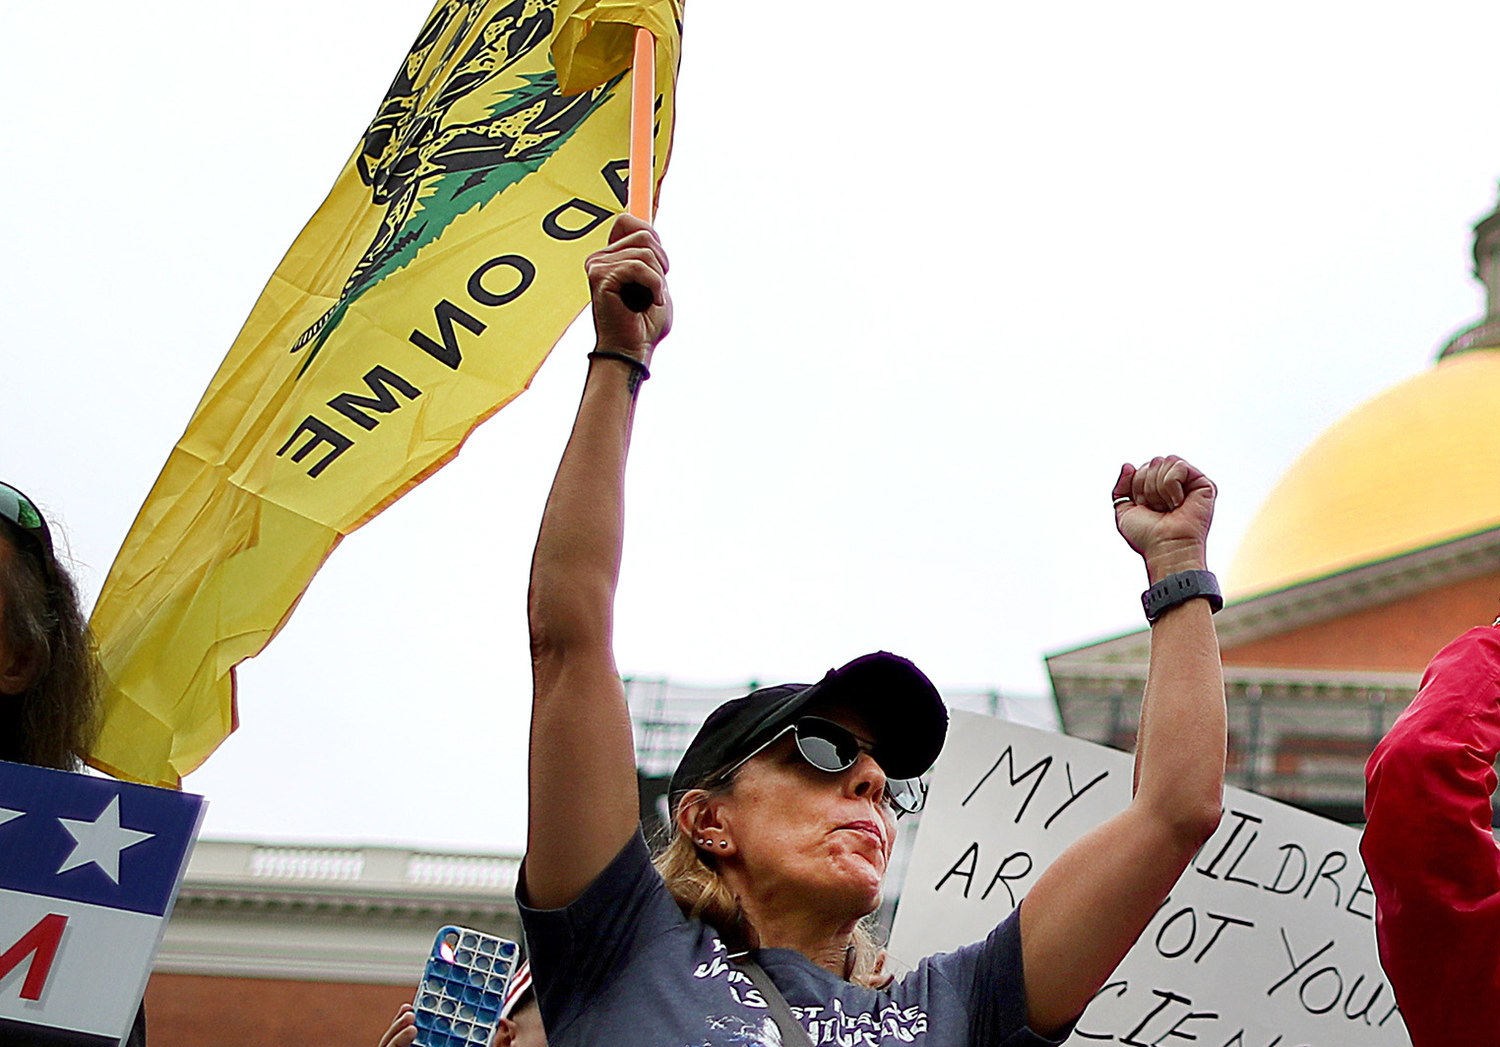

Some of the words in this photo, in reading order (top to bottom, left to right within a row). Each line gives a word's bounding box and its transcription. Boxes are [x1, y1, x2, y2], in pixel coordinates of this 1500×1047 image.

[962, 745, 1109, 830] MY
[935, 841, 1034, 908] AR
[1155, 897, 1254, 964] OT
